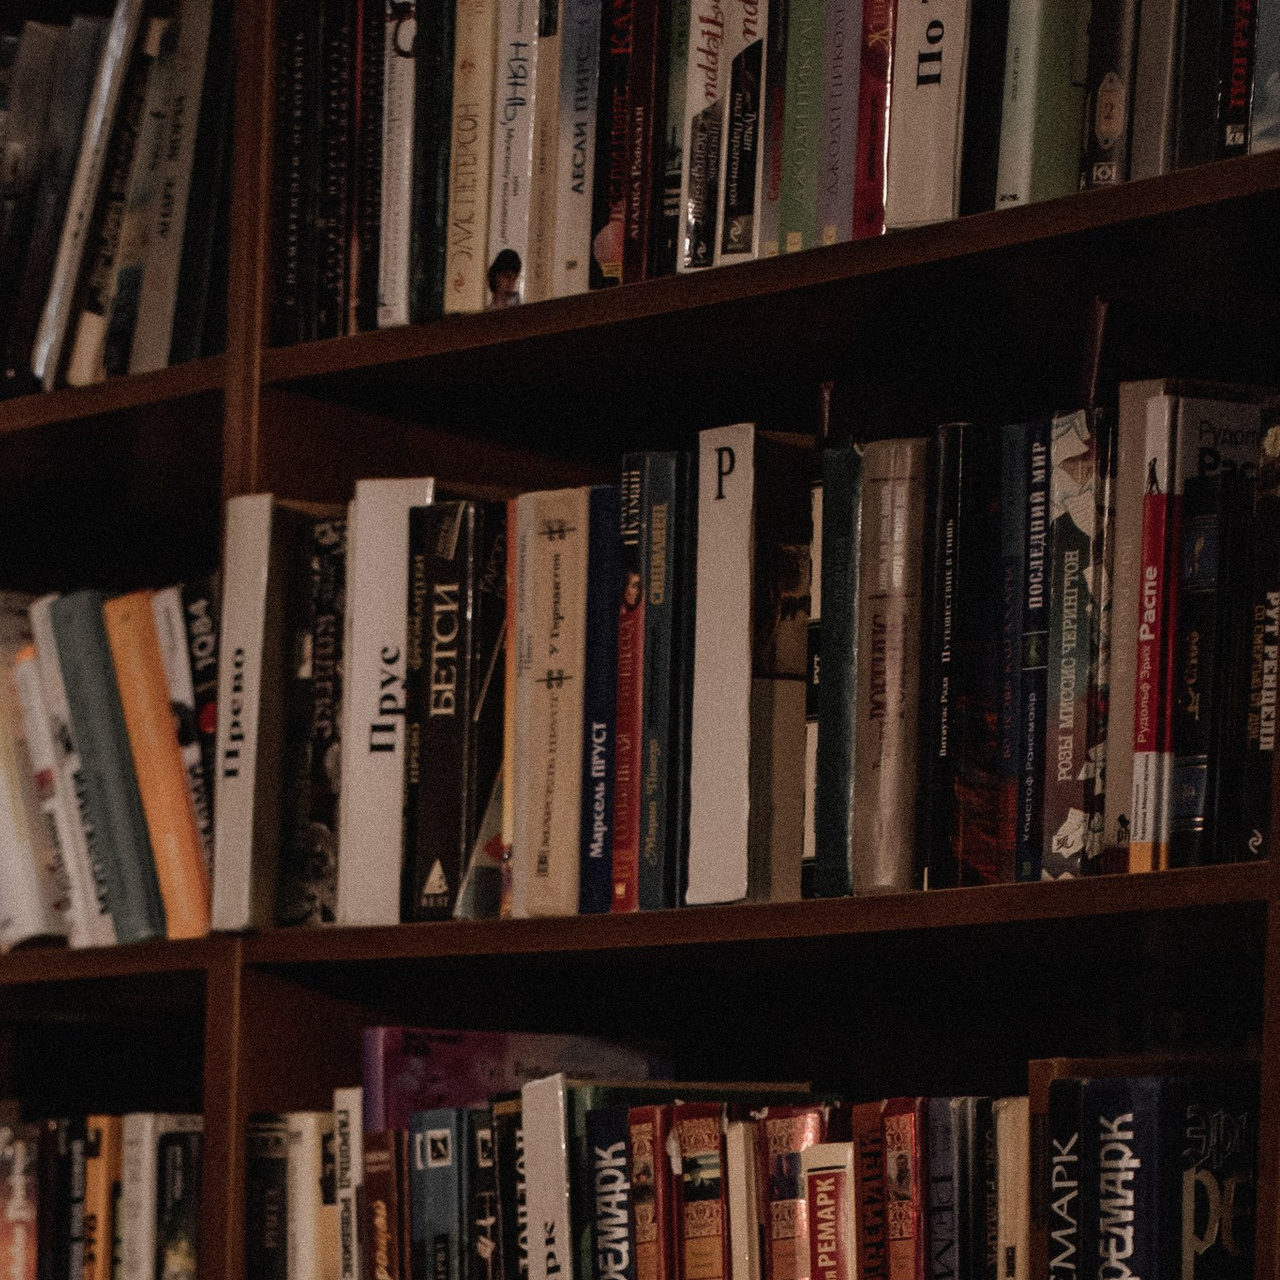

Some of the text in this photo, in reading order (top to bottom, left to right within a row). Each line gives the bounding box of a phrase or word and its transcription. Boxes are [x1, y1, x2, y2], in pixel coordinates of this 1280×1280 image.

[825, 7, 846, 196] ДЖОДИ ПИКОЛТ
[917, 20, 945, 88] По
[454, 102, 480, 205] ПЕТЕРСОН
[742, 112, 757, 152] Туман
[793, 113, 809, 204] ДЖОДИ
[1027, 439, 1048, 610] ПОСЛЕДНИЙ МИР
[187, 597, 216, 671] 1Q84
[428, 582, 462, 717] БЕТСИ
[1139, 565, 1158, 642] Распе
[222, 646, 246, 780] Прево
[369, 645, 407, 754] Прус
[1057, 549, 1080, 782] РОЗЫ МИССИС ЧЕРИНГТОН
[1136, 682, 1152, 744] Рудольф
[1259, 590, 1280, 752] РУТ РЕНДЕЛЛ
[588, 721, 609, 859] Марсель ПРУСТ
[337, 1109, 352, 1190] ГАРОЛЬД
[340, 1198, 354, 1279] РОББИНС
[815, 1177, 838, 1268] РЕМАРК
